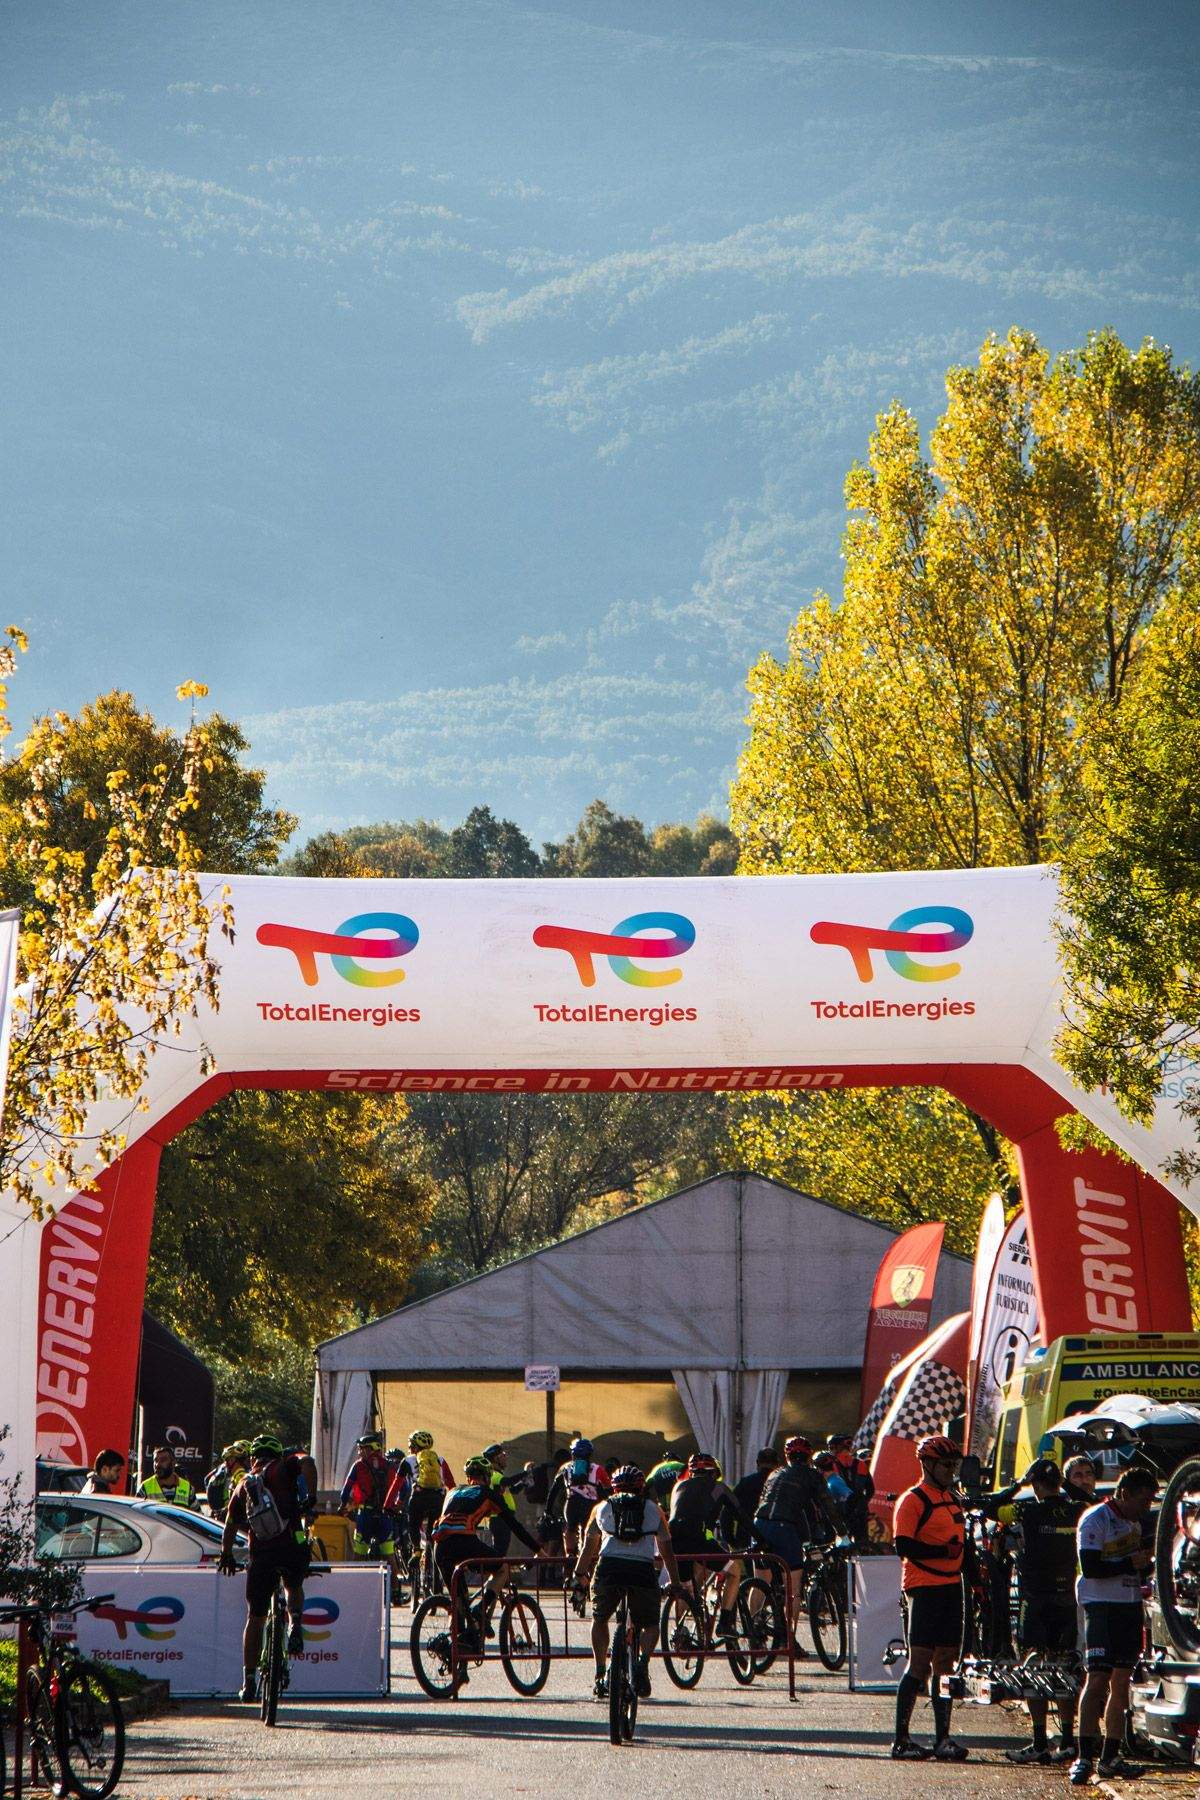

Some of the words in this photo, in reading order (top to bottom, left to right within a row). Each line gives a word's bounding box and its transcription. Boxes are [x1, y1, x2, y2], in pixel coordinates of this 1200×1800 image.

[256, 1002, 421, 1026] TotalEnergies
[533, 1003, 698, 1026] TotalEnergies
[811, 997, 976, 1021] TotalEnergies
[325, 1070, 526, 1089] Science
[543, 1072, 592, 1089] in
[609, 1069, 845, 1088] Nutrition
[1073, 1176, 1140, 1335] ERVIT
[997, 1272, 1037, 1297] INFORMACI
[873, 1318, 928, 1330] ACADEMY
[1082, 1363, 1200, 1378] AMBULANC
[145, 1444, 203, 1458] LBEL
[91, 1648, 184, 1664] TotalEnergies
[289, 1649, 339, 1664] nergies
